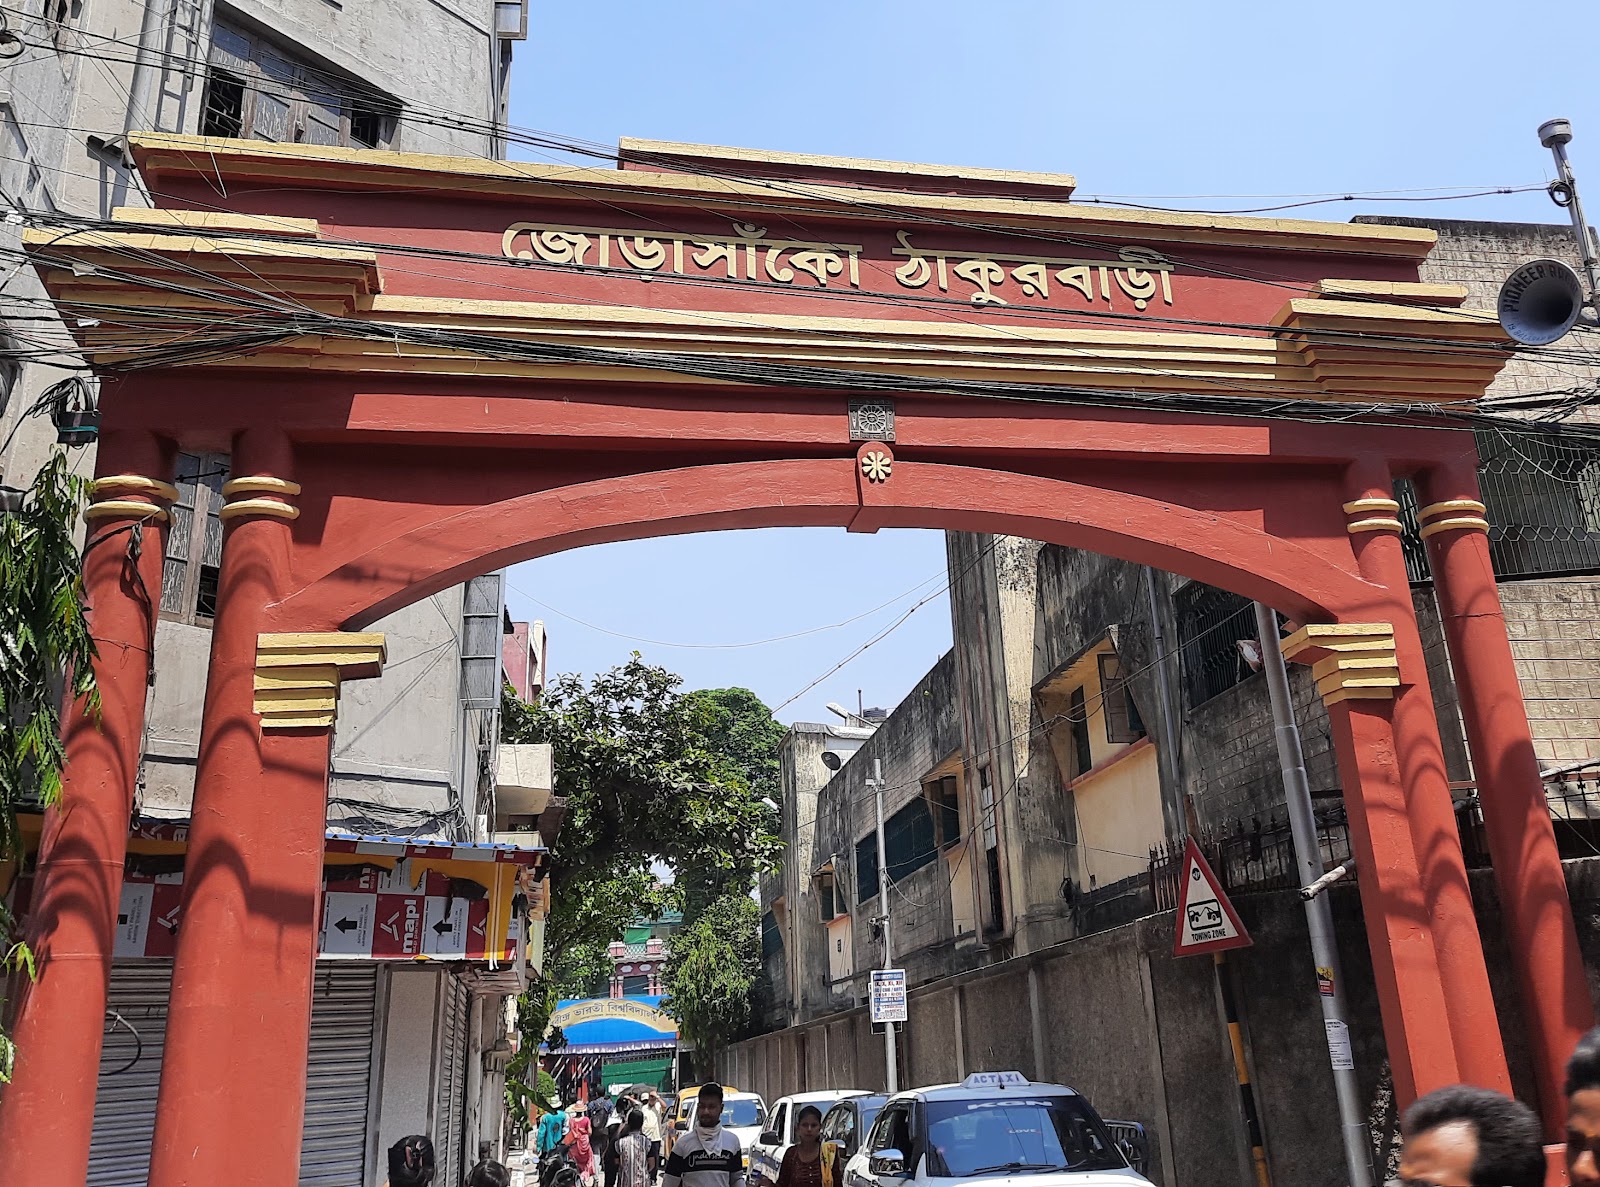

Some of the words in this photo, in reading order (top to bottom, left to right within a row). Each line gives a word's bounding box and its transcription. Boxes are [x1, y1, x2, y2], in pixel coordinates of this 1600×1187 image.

[501, 221, 863, 289] জোড়াসাঁকো
[1503, 265, 1546, 312] PIONEER
[402, 899, 420, 954] mapl
[1191, 931, 1211, 941] TOWING
[1212, 928, 1226, 938] ZONE
